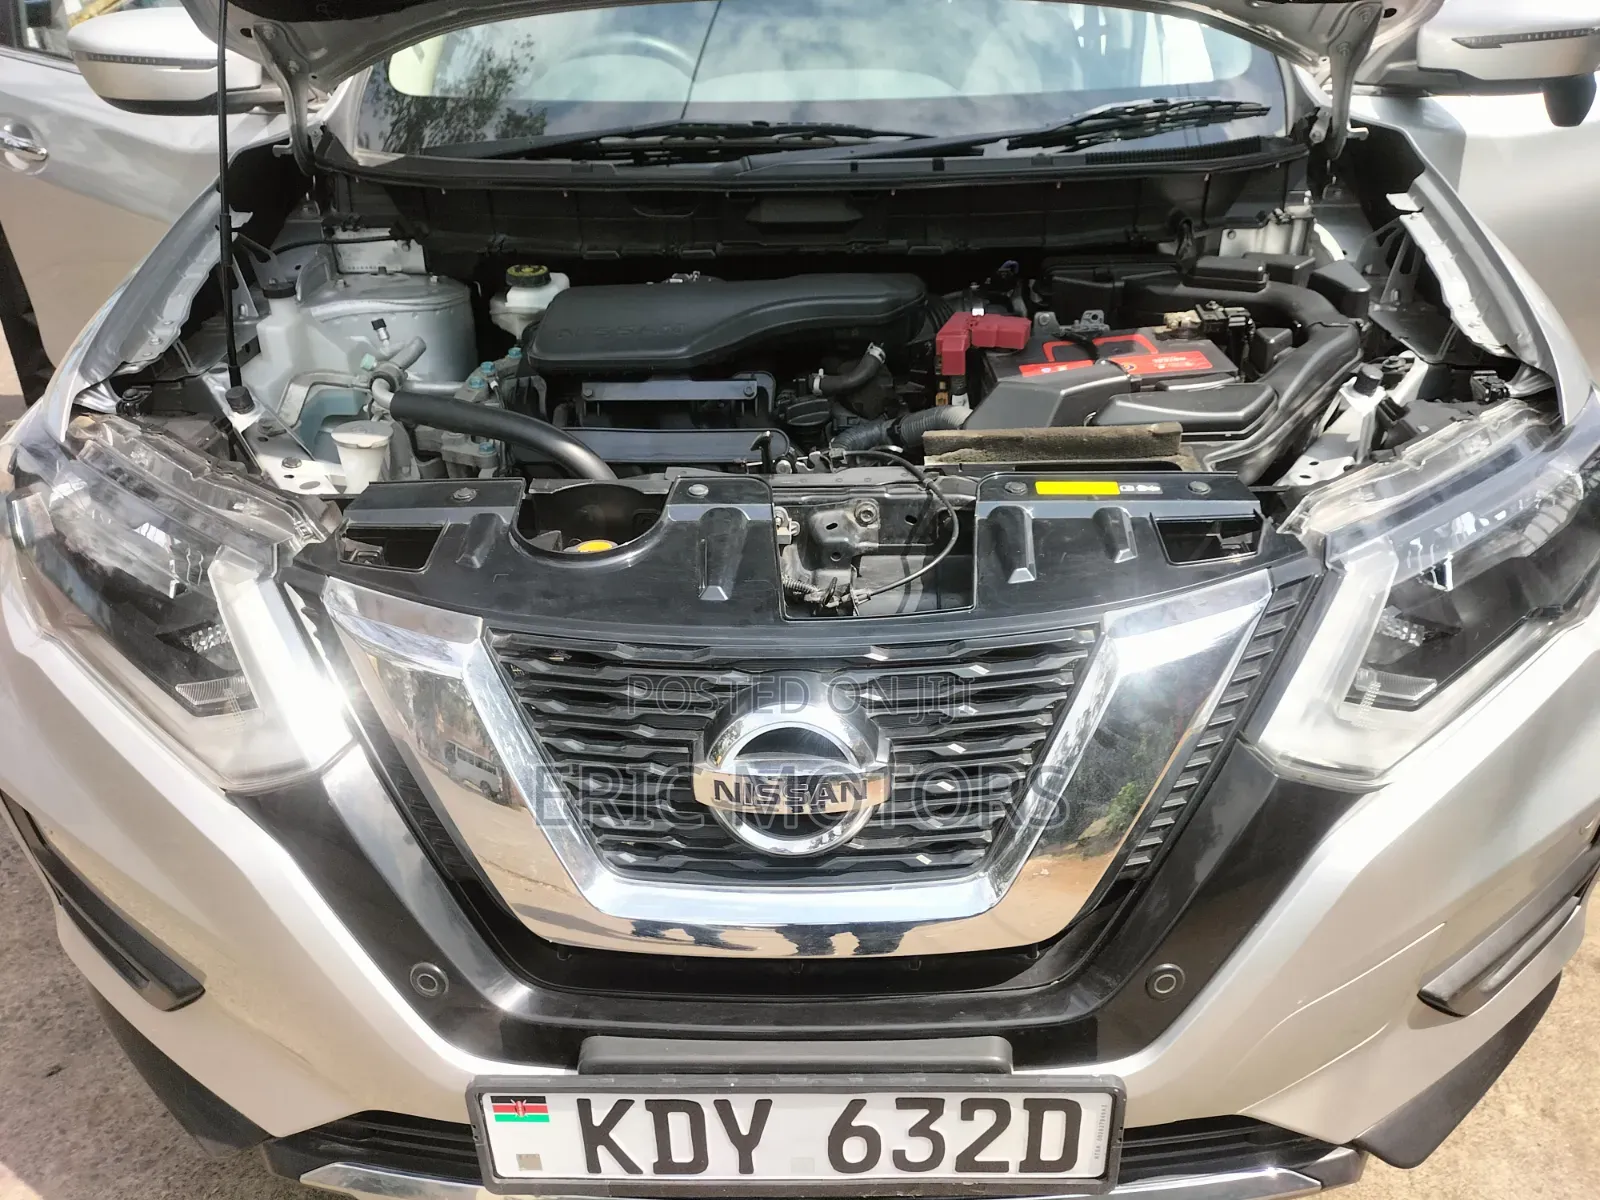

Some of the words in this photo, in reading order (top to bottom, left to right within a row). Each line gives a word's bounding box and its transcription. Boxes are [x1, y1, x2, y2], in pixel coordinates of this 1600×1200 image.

[713, 778, 869, 806] NISSAN
[577, 1097, 773, 1175] KDY
[827, 1097, 1082, 1174] 632D
